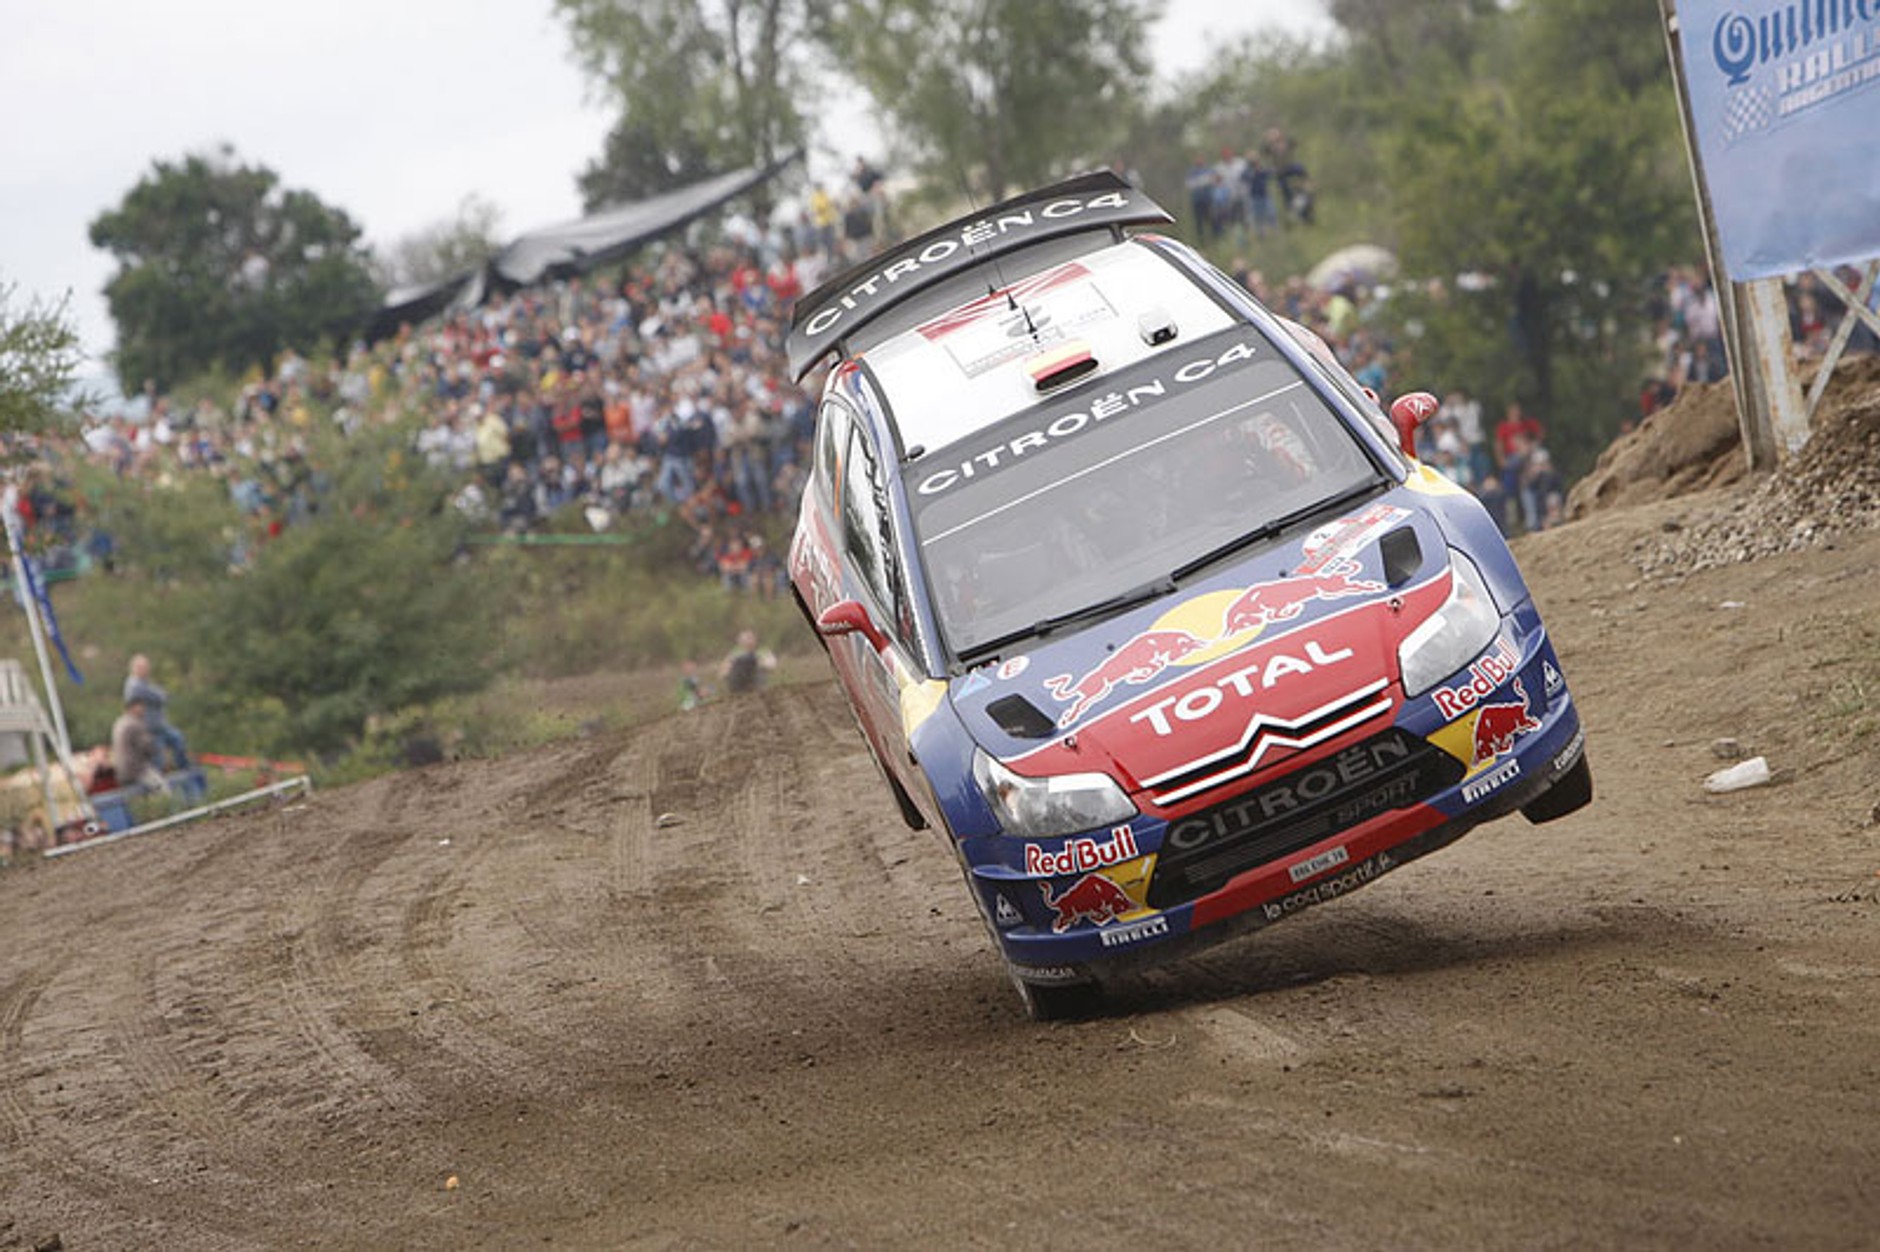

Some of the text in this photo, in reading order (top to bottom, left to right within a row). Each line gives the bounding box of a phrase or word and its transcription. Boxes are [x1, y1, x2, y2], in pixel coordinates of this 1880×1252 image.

[805, 191, 1129, 336] CITROËN C4
[918, 343, 1257, 496] CITROËN C4
[1130, 641, 1354, 735] TOTAL
[1432, 636, 1522, 720] Red Bull
[1170, 734, 1409, 849] CITROËN
[1337, 770, 1421, 823] SPORT
[1462, 758, 1520, 803] PIRELLI
[1025, 824, 1138, 876] Red Bull
[1101, 918, 1169, 947] PIRELLI
